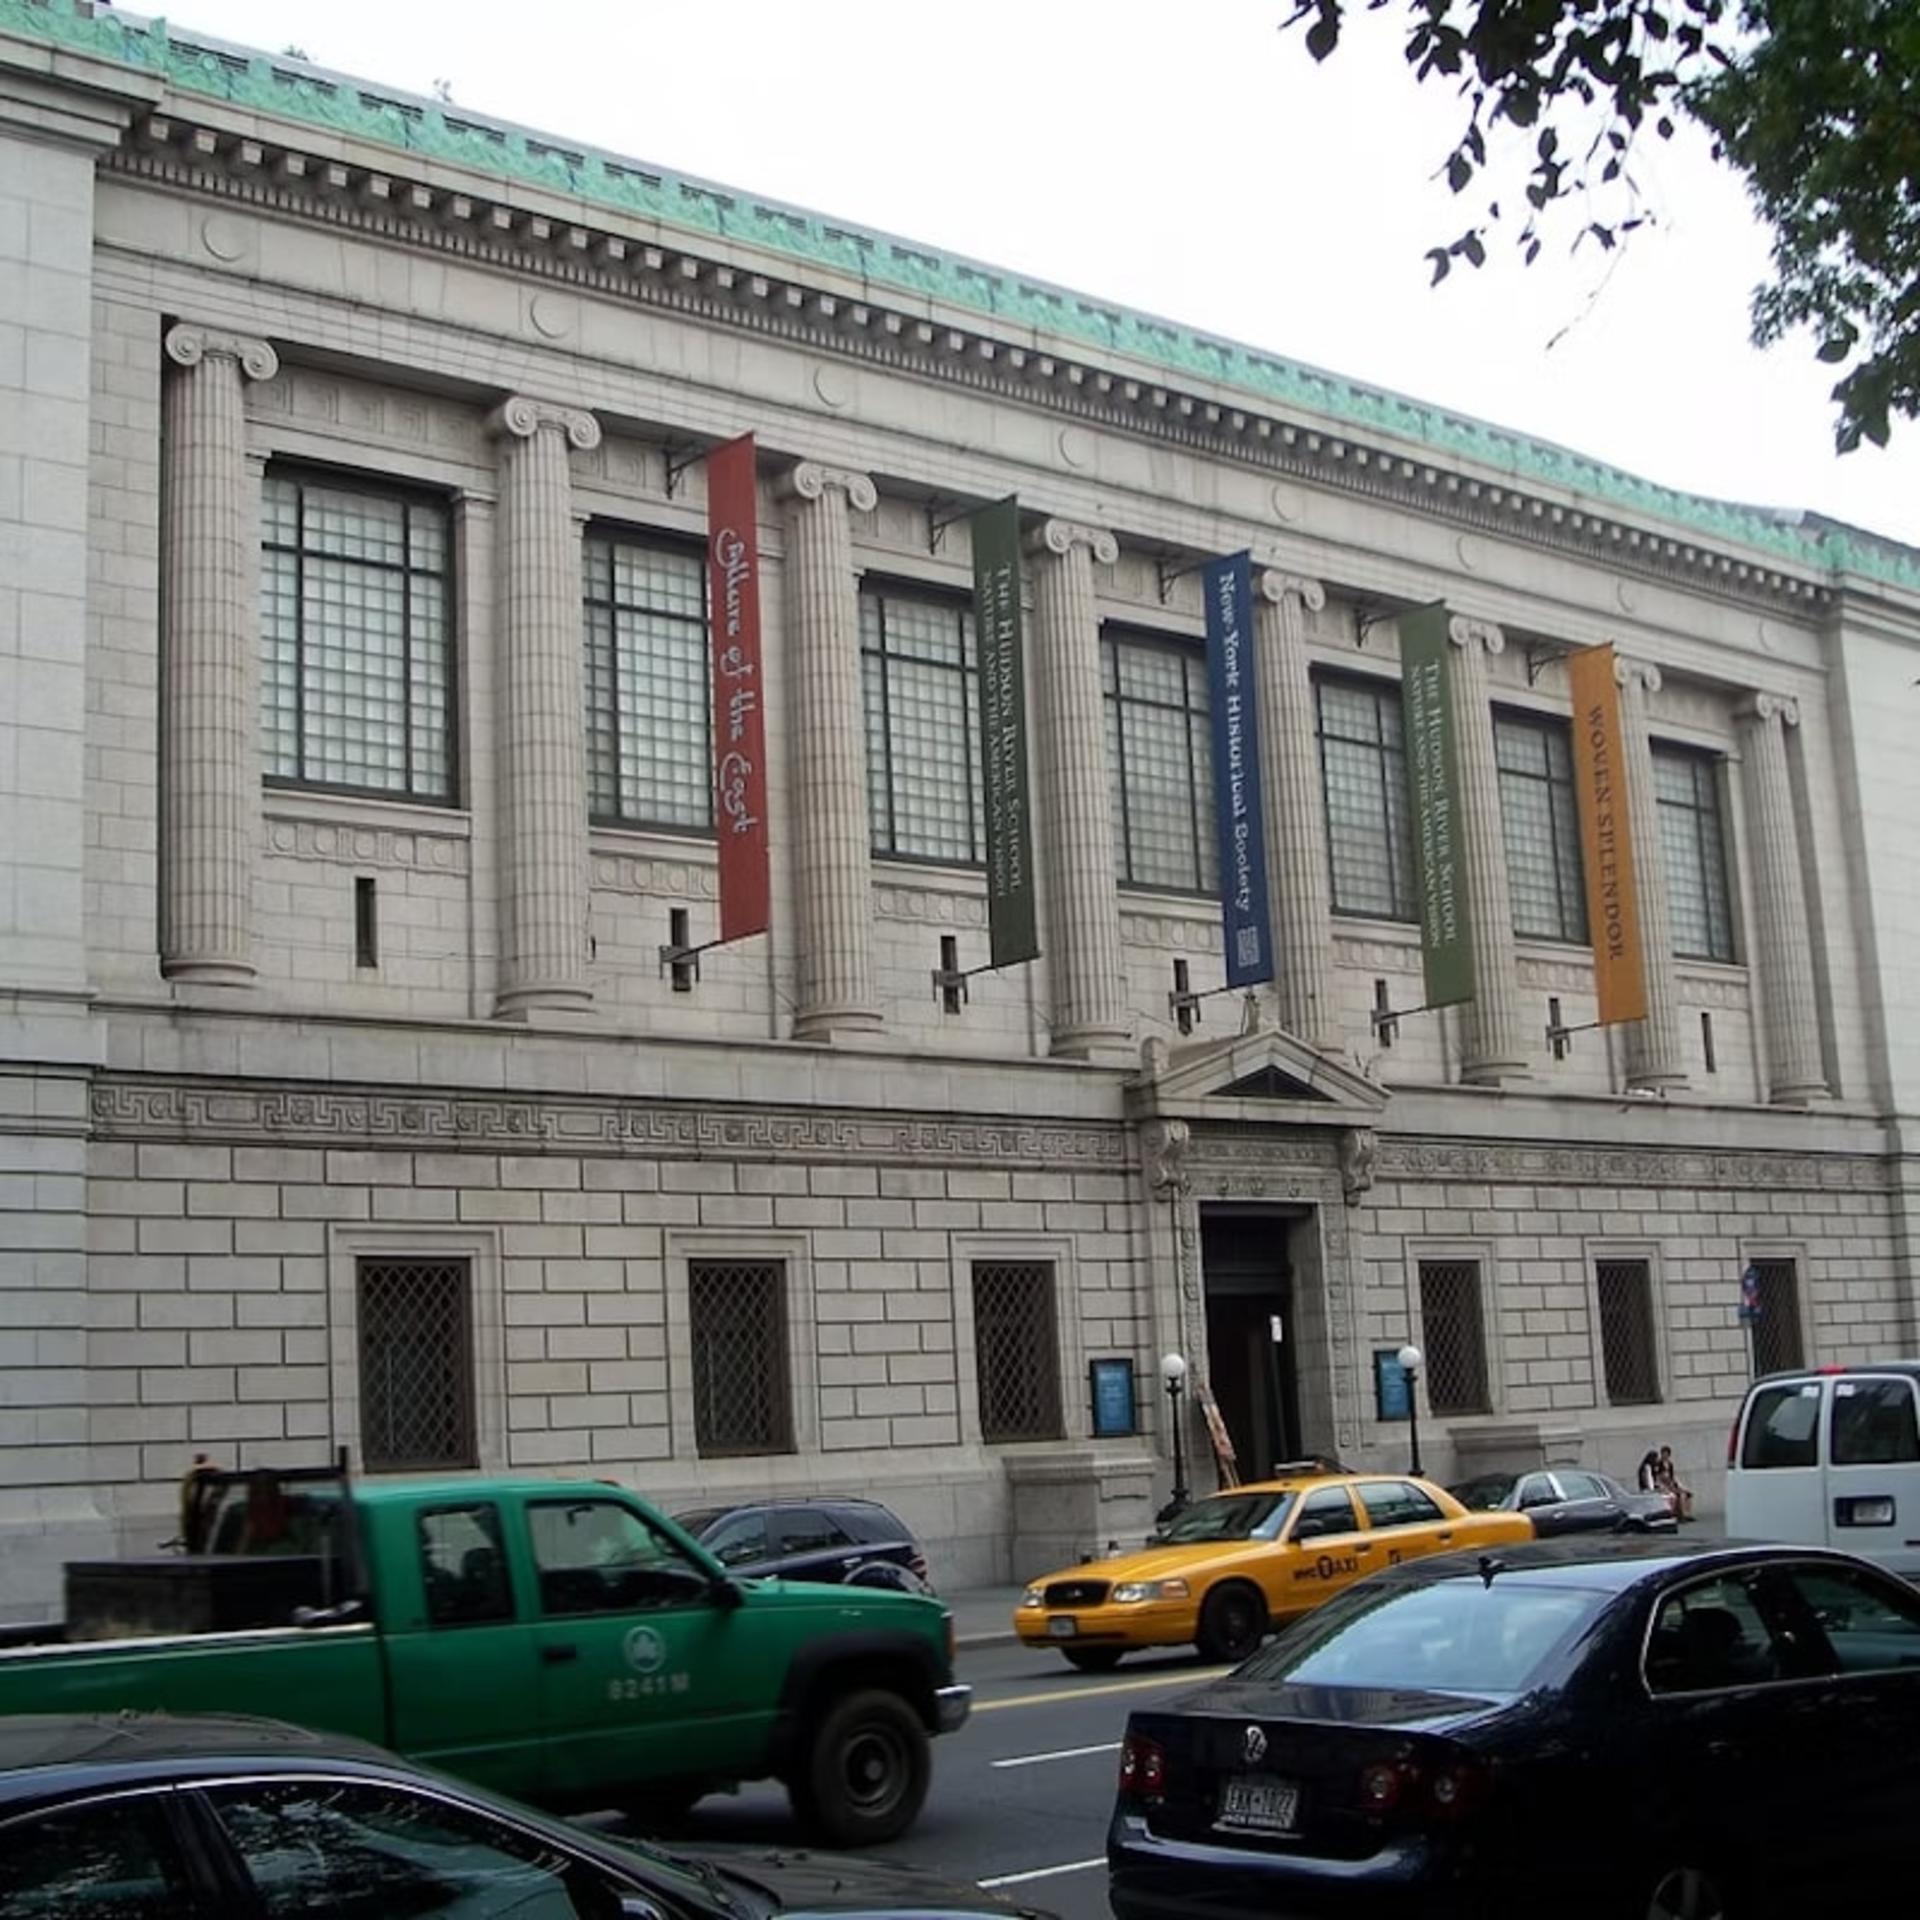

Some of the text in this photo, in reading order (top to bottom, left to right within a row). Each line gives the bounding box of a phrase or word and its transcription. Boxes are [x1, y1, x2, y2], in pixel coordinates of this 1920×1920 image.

[716, 529, 757, 833] Allure of the East
[998, 619, 1015, 716] HUDSON
[1002, 724, 1017, 792] RIVER
[1227, 696, 1246, 815] Historical
[1427, 708, 1445, 792] HUDSON
[1007, 799, 1021, 892] SCHOOL
[1234, 822, 1252, 911] Society
[1434, 798, 1449, 857] RIVER
[1588, 706, 1624, 961] WOVEN SPLENDOR
[1439, 863, 1456, 944] SCHOOL
